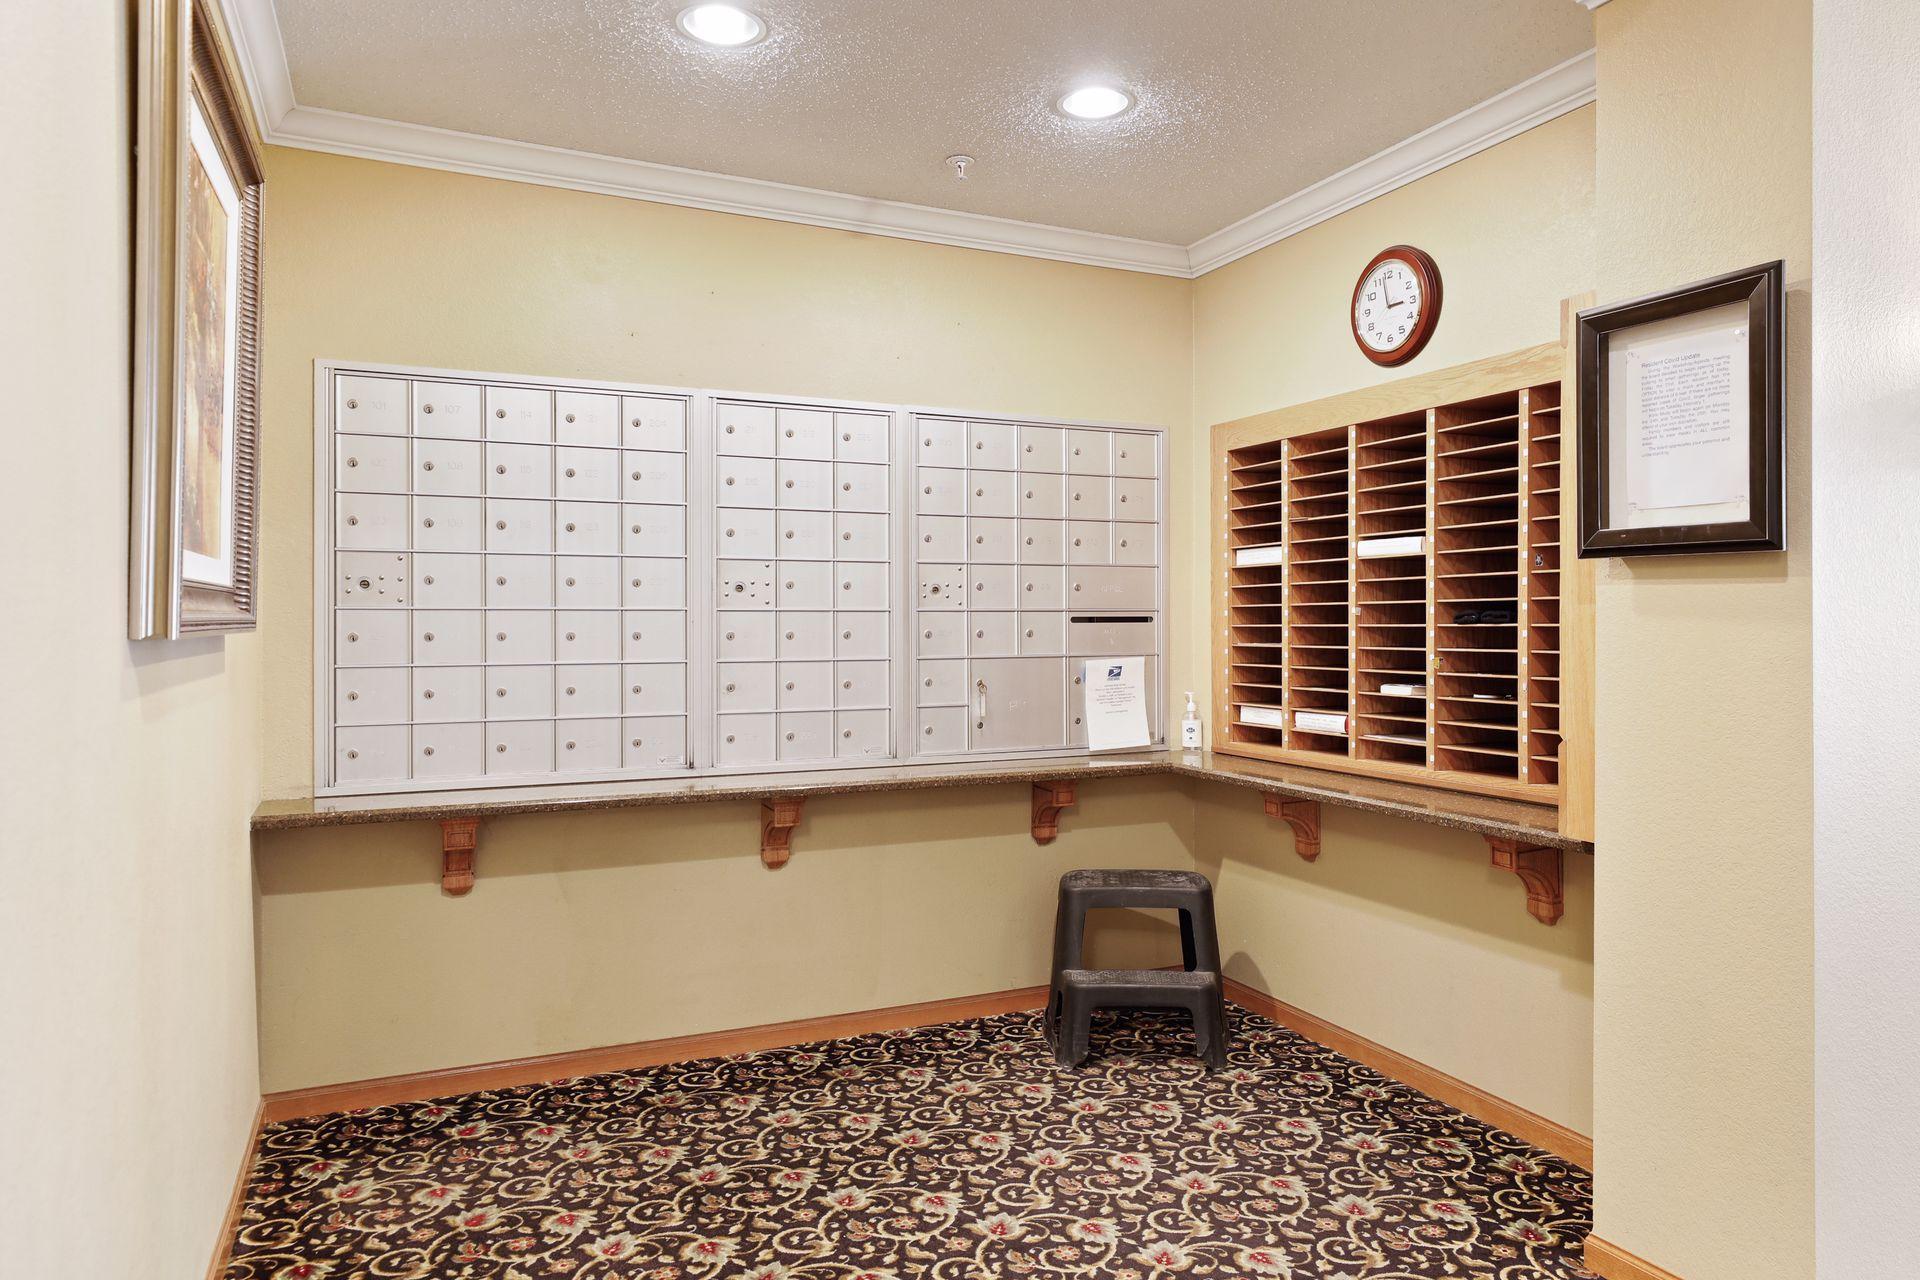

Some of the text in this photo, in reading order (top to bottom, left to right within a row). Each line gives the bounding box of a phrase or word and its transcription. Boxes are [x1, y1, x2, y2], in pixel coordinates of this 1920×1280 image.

[1384, 271, 1394, 280] 12
[1374, 279, 1382, 288] 11
[1406, 281, 1412, 290] 2
[1366, 292, 1376, 301] 10
[1410, 296, 1416, 304] 3
[1368, 323, 1374, 331] 8
[1398, 326, 1406, 334] 5
[1641, 359, 1663, 368] Resident
[1664, 356, 1680, 365] Covid
